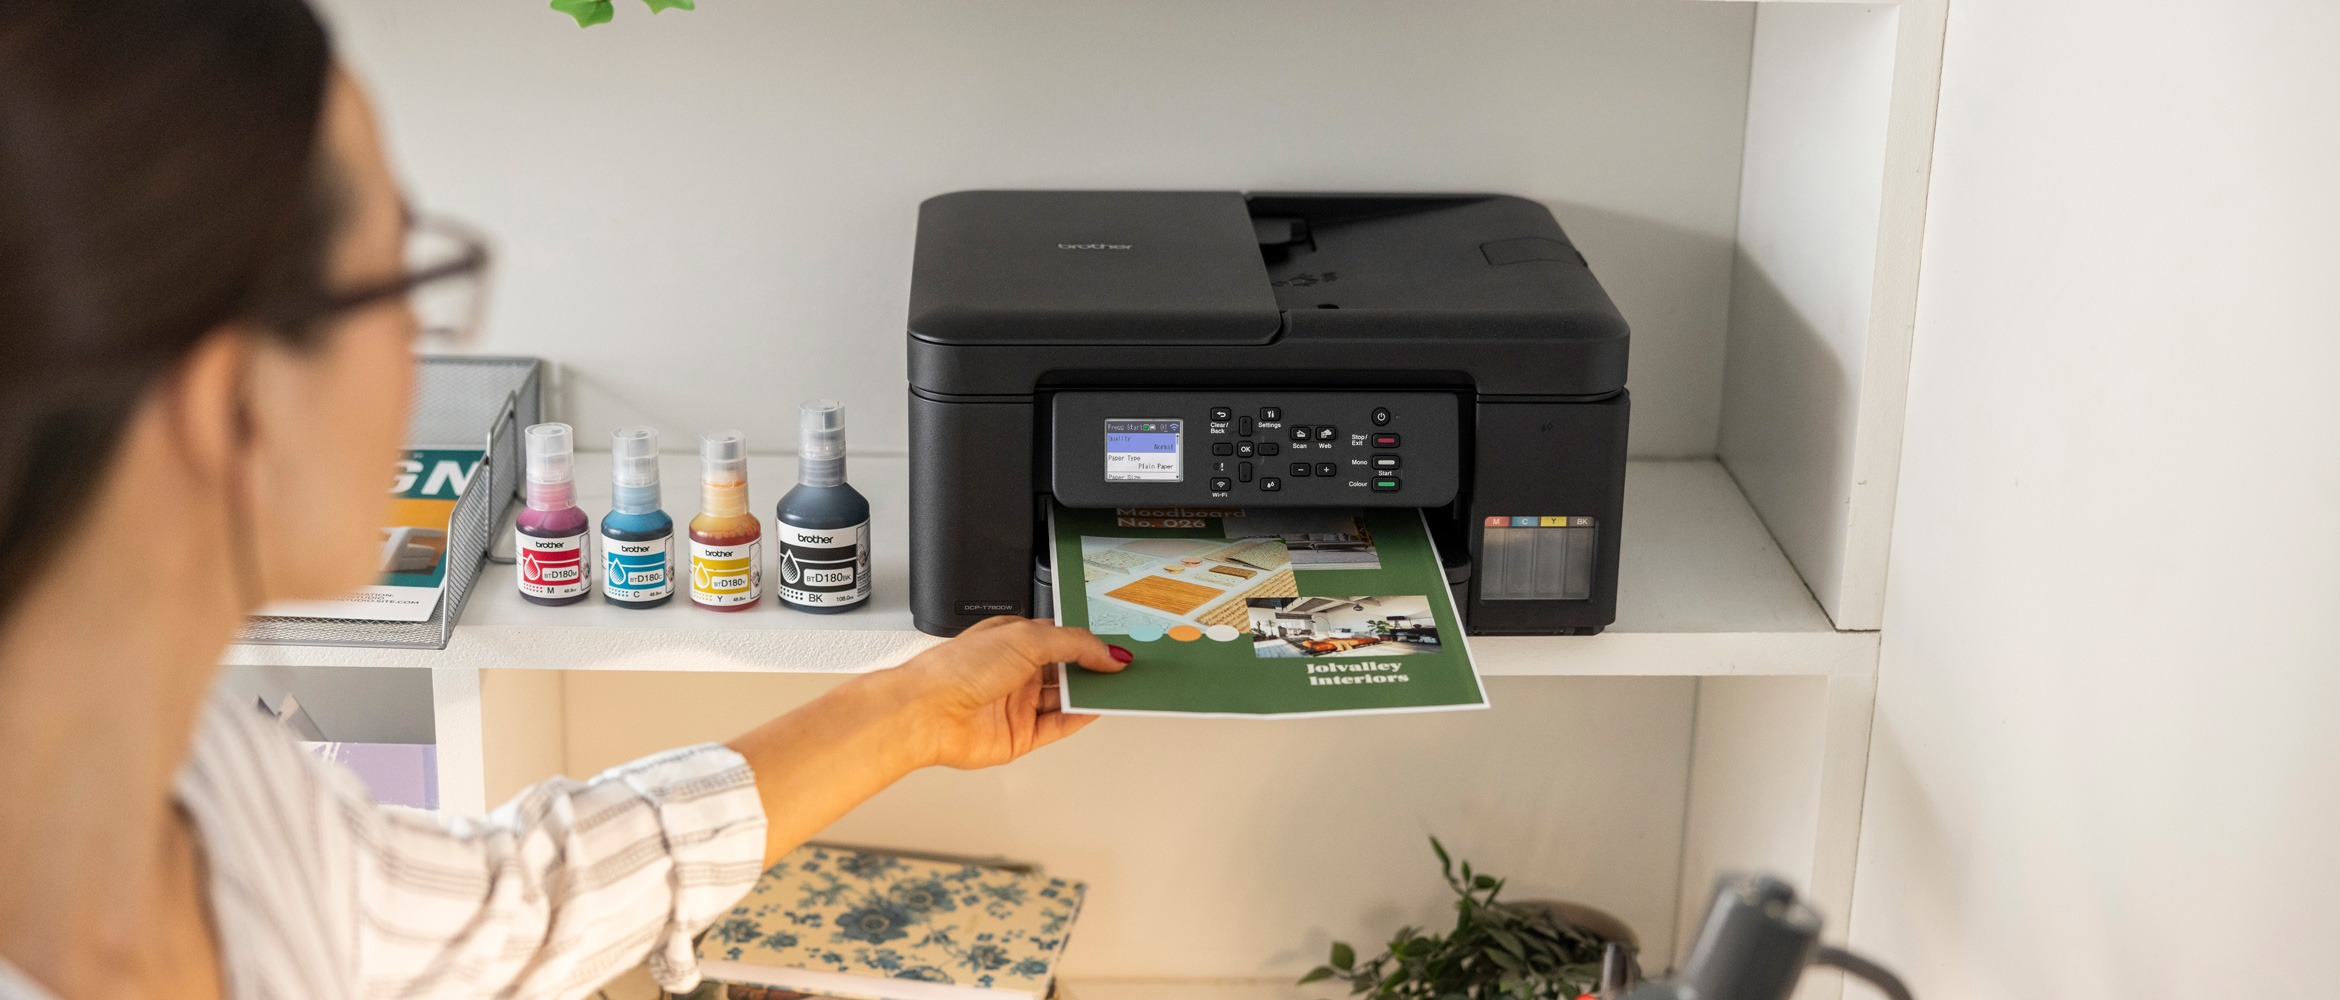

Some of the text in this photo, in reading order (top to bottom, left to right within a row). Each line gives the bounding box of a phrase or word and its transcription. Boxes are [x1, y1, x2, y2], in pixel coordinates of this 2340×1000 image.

[1108, 455, 1124, 463] Paper
[1157, 463, 1174, 471] Paper
[1116, 507, 1247, 518] Moodboard
[1117, 517, 1206, 528] No. 026
[797, 533, 834, 544] brother
[535, 541, 565, 549] brother
[621, 545, 650, 553] brother
[705, 549, 733, 558] brother
[808, 594, 823, 602] BK
[1306, 661, 1402, 674] Jolvalley
[1309, 674, 1409, 686] Interiors
